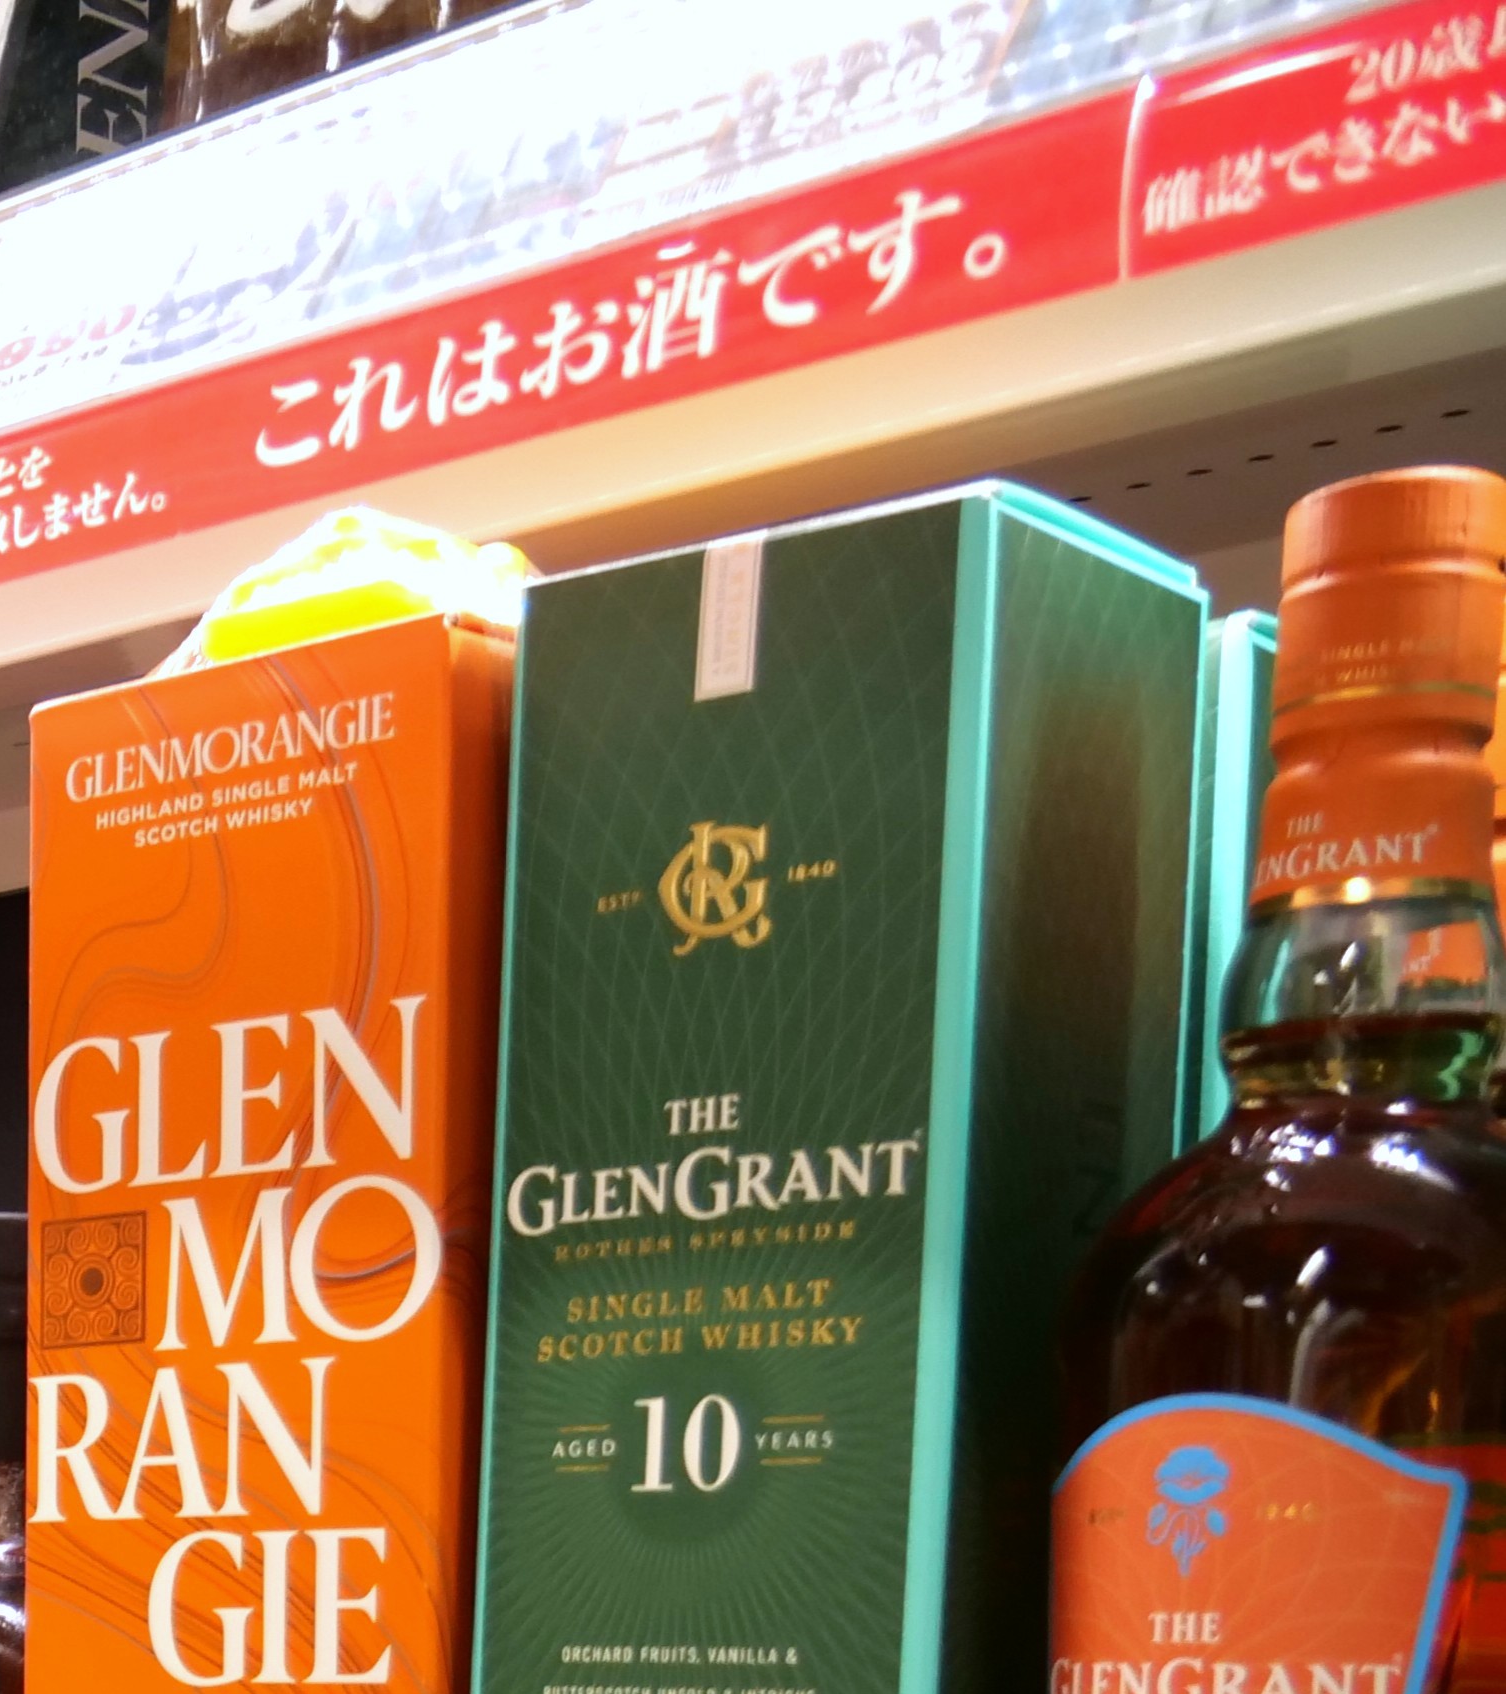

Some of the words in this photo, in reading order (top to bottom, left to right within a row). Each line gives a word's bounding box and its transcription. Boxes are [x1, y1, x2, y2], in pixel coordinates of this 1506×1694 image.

[255, 190, 1007, 469] これはお酒です。
[65, 692, 396, 802] GLENMORANGIE
[95, 792, 203, 830] HIGHLAND
[211, 775, 291, 809] SINGLE
[298, 762, 358, 791] MALT
[133, 815, 218, 848] SCOTCH
[225, 798, 313, 830] WHISKY
[33, 994, 427, 1195] GLEN
[664, 1094, 740, 1135] THE
[154, 1175, 445, 1352] MO
[567, 1286, 704, 1322] SINGLE
[721, 1280, 831, 1313] MALT
[537, 1328, 683, 1362] SCOTCH
[701, 1316, 863, 1351] WHISKY
[28, 1356, 336, 1524] RAN
[552, 1437, 615, 1459] AGED
[631, 1393, 740, 1492] 10
[755, 1430, 834, 1450] YEARS
[148, 1527, 392, 1687] GIE
[1148, 1612, 1220, 1645] THE
